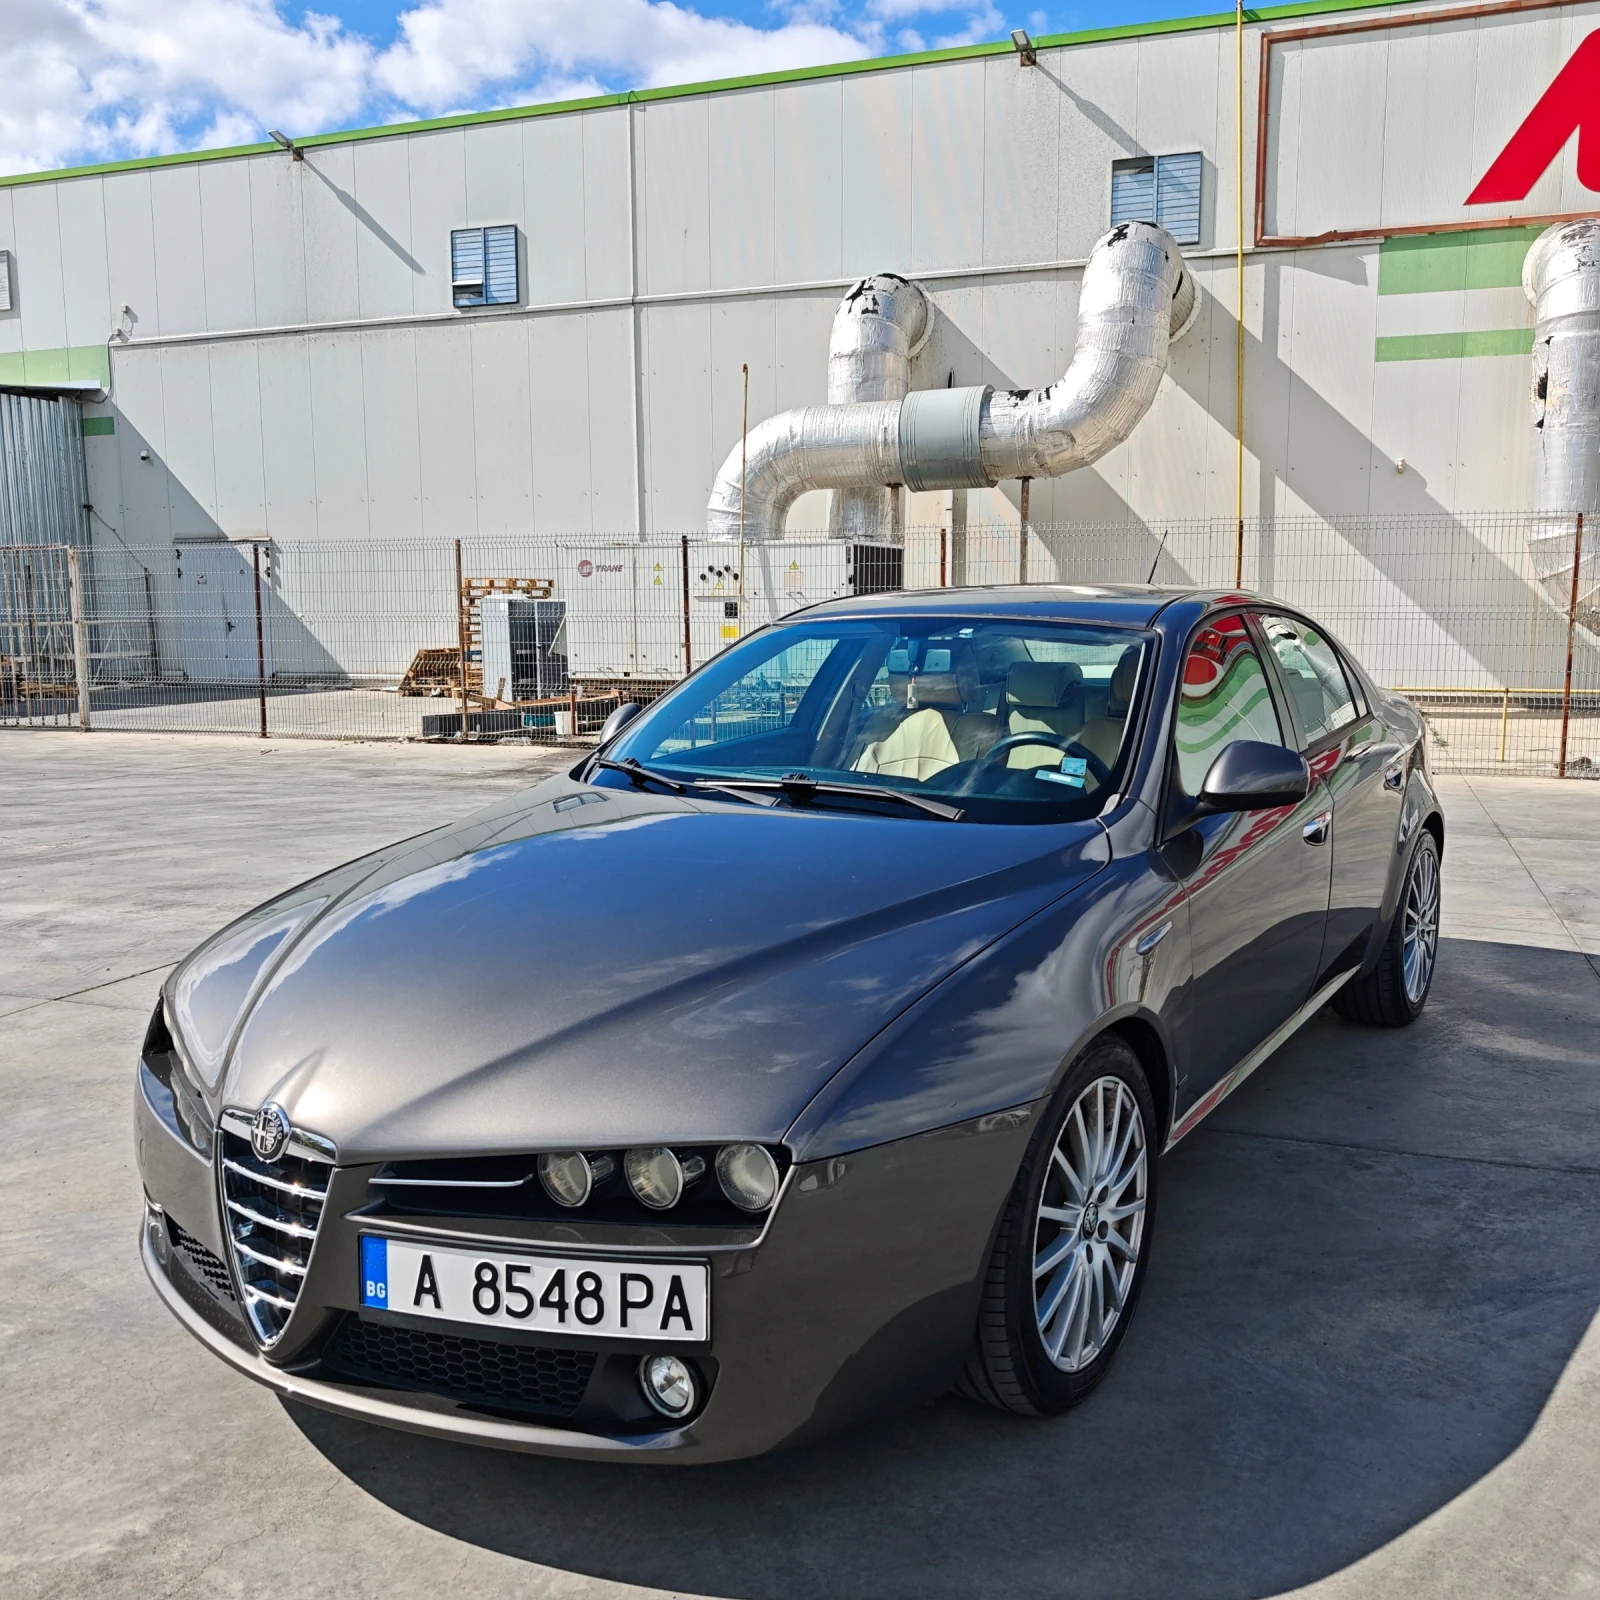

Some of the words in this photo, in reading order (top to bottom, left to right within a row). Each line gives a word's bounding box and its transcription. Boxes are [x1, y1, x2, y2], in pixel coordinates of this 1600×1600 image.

[595, 564, 624, 572] TRANE
[366, 1280, 386, 1298] BG
[413, 1254, 442, 1309] A
[473, 1261, 604, 1325] 8548
[619, 1273, 694, 1332] PA
